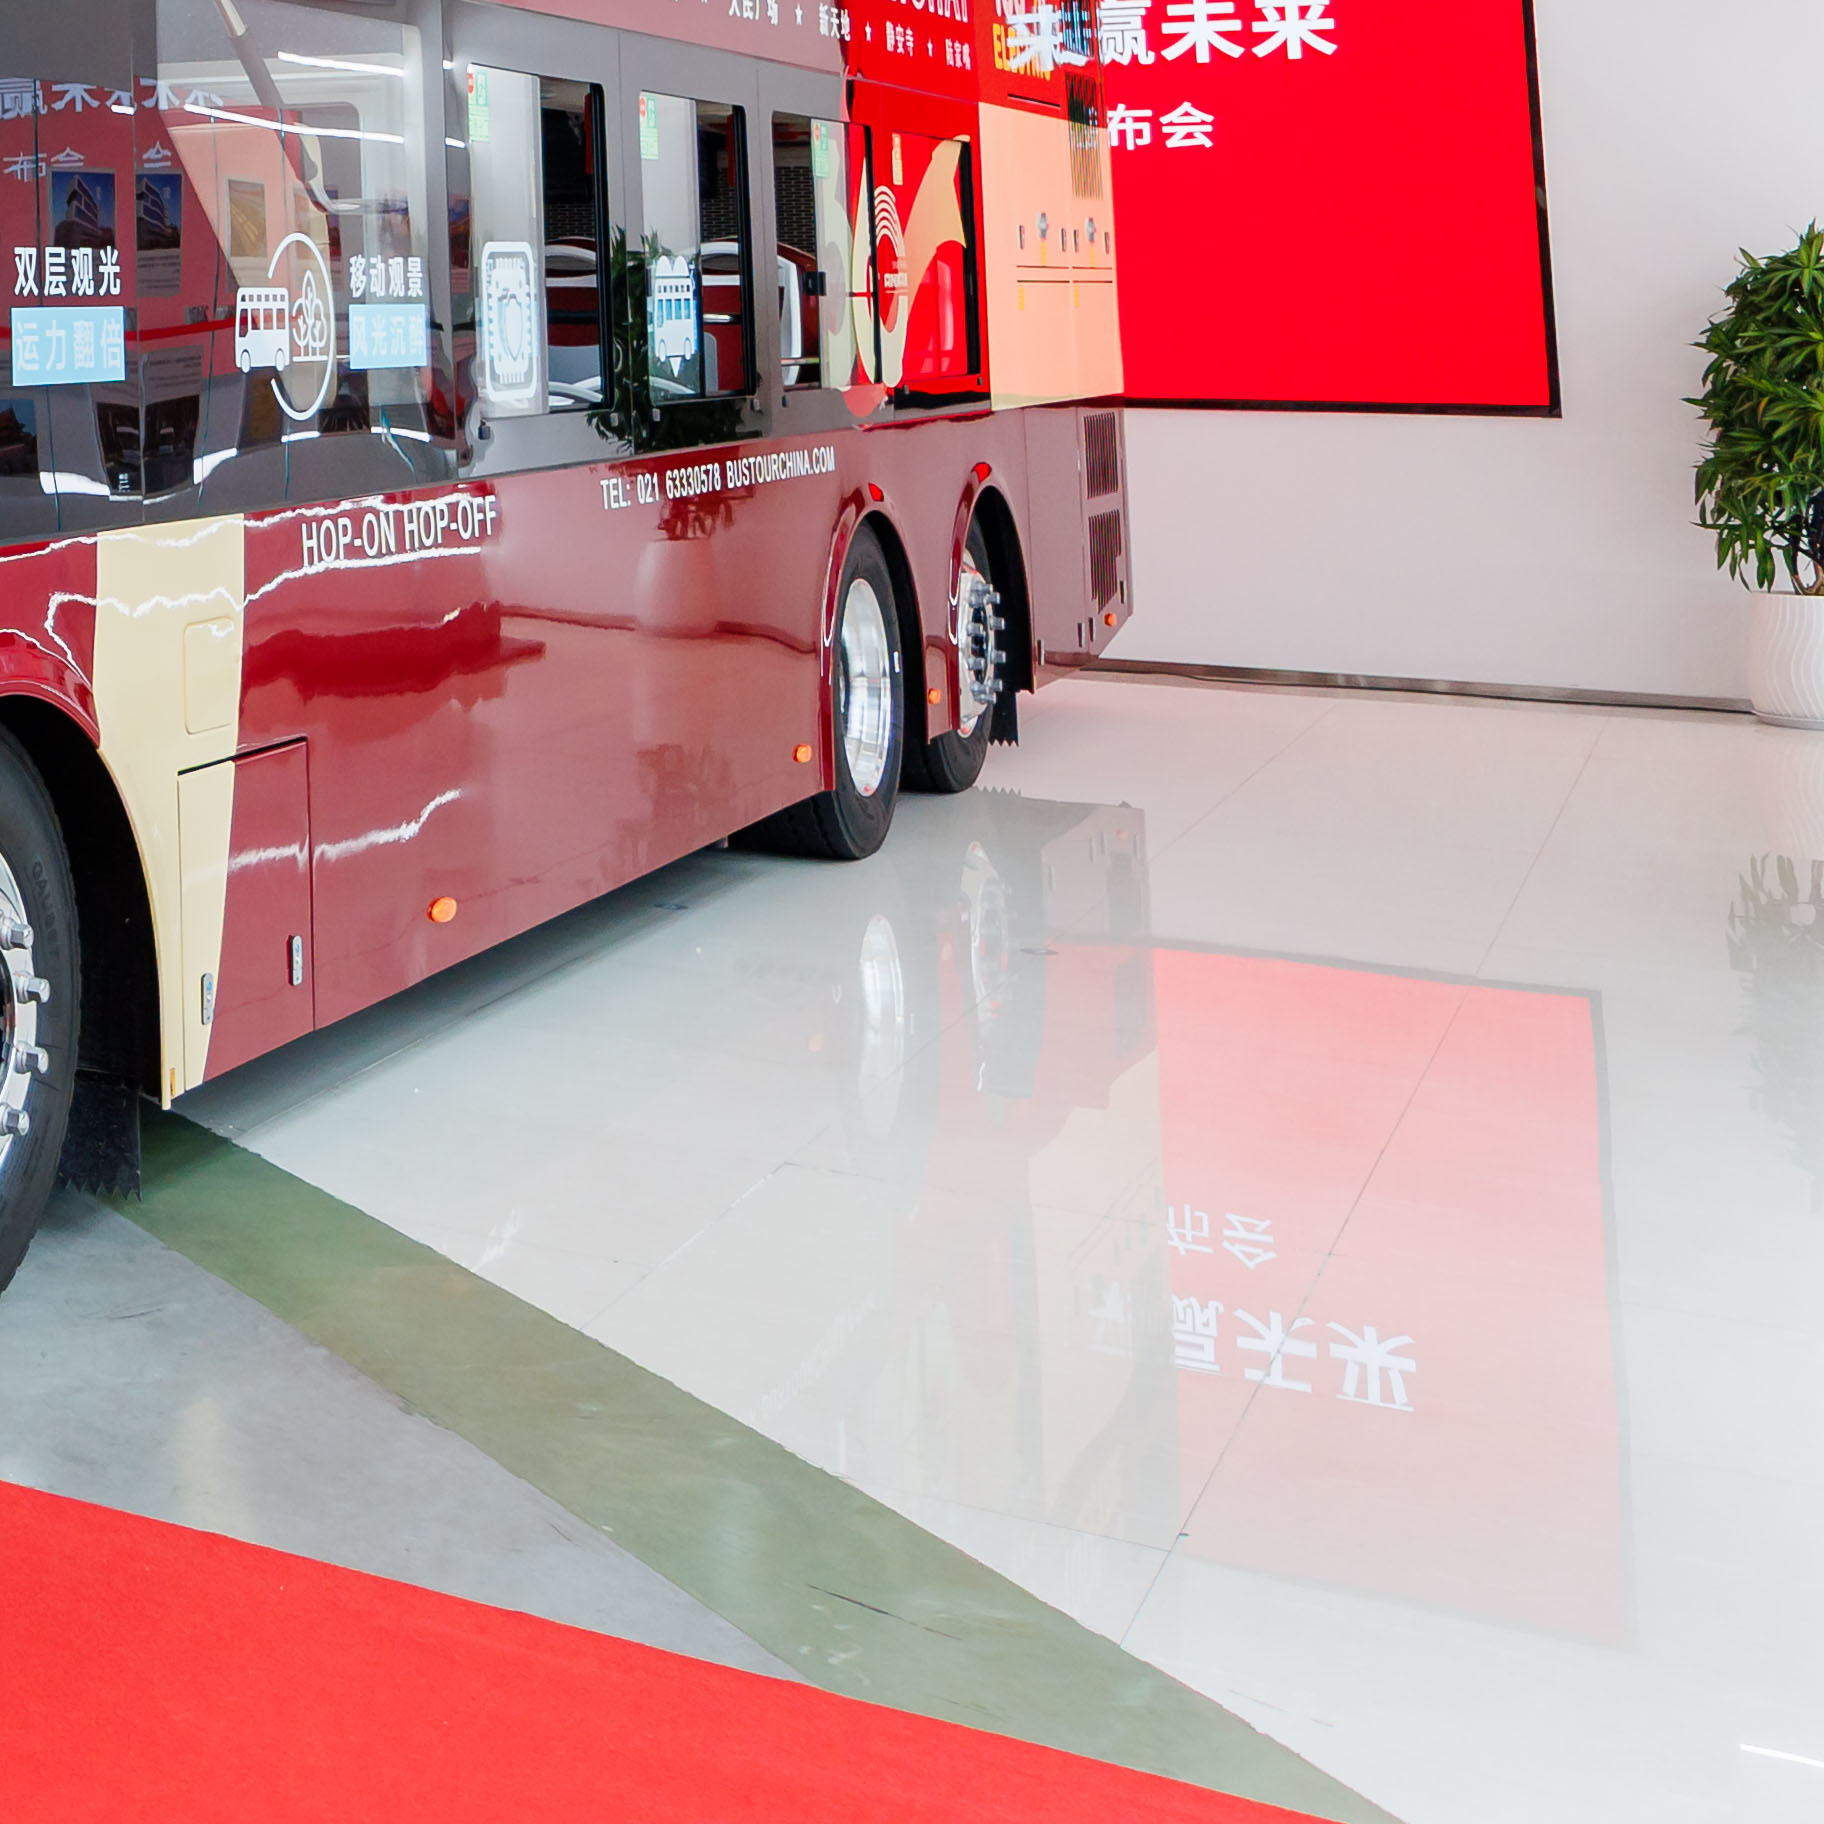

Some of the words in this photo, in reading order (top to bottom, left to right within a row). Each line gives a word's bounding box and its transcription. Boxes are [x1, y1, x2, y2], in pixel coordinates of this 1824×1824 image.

[819, 2, 851, 42] 新天地
[1106, 101, 1215, 151] 布会
[14, 246, 121, 297] 双层观光
[349, 254, 423, 298] 移动观景
[15, 318, 125, 372] 运力翻倍
[600, 477, 631, 510] TEL:
[636, 474, 659, 502] 021
[665, 464, 721, 498] 63330578
[727, 446, 835, 489] BUSTOURCHINA.COM
[301, 509, 397, 570] HOP-ON
[404, 495, 497, 550] HOP-OFF
